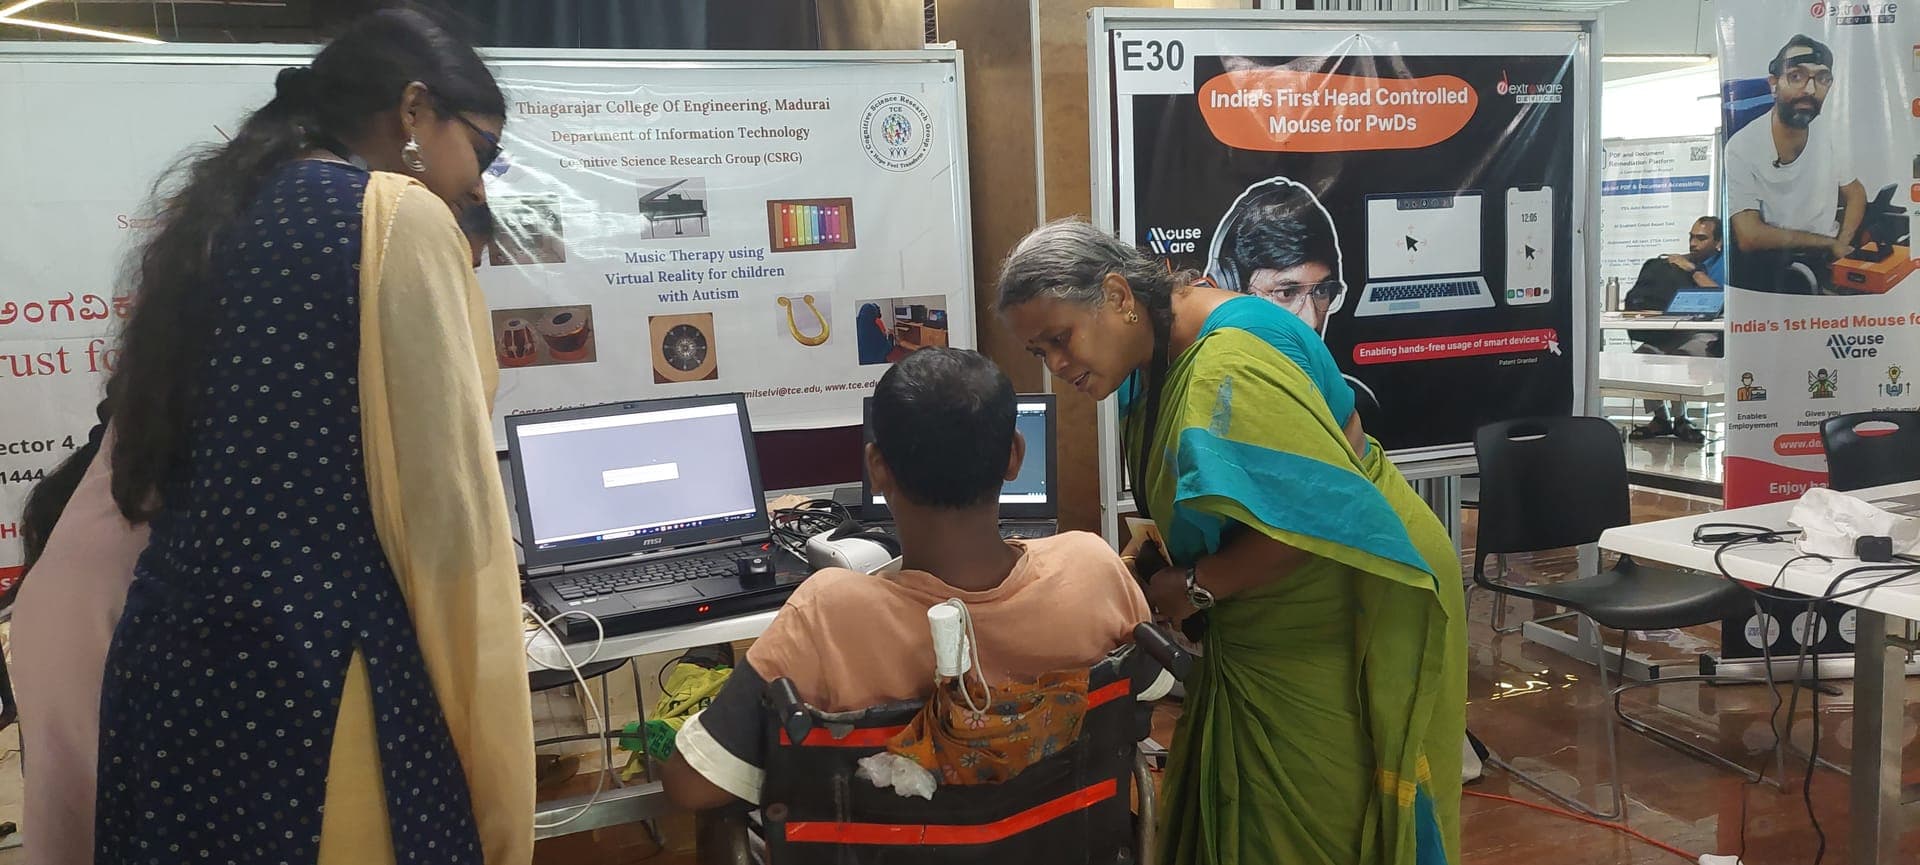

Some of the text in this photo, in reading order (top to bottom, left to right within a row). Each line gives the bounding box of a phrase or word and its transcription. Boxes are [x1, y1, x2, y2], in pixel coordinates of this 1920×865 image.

[1122, 40, 1184, 71] E30
[1211, 86, 1468, 108] India's First Head Controlled
[516, 97, 830, 117] Thiagarajar College Of Engineering, Madurai
[1269, 114, 1416, 134] Mouse for PwDs
[552, 125, 810, 144] Department of Information Technology
[621, 155, 666, 167] Science
[670, 154, 722, 166] Research
[725, 153, 761, 167] Group
[763, 152, 803, 165] (CSRG)
[1146, 227, 1201, 241] Mouse
[1150, 240, 1195, 254] Ware
[625, 247, 764, 264] Music Therapy using
[605, 264, 784, 285] Virtual Reality for children
[658, 287, 739, 302] with Autism
[1731, 319, 1779, 333] India's
[1784, 318, 1806, 331] 1st
[1811, 316, 1849, 330] Head
[1853, 314, 1905, 328] Mouse
[1360, 335, 1540, 358] Enabling hands-free usage of smart devices
[1826, 334, 1884, 346] Mouse
[1829, 347, 1877, 359] Ware
[1737, 413, 1767, 421] Enables
[1805, 410, 1841, 418] Gives you
[1729, 422, 1778, 430] Employement
[1780, 439, 1824, 449] www.de
[1769, 481, 1807, 496] Enjoy
